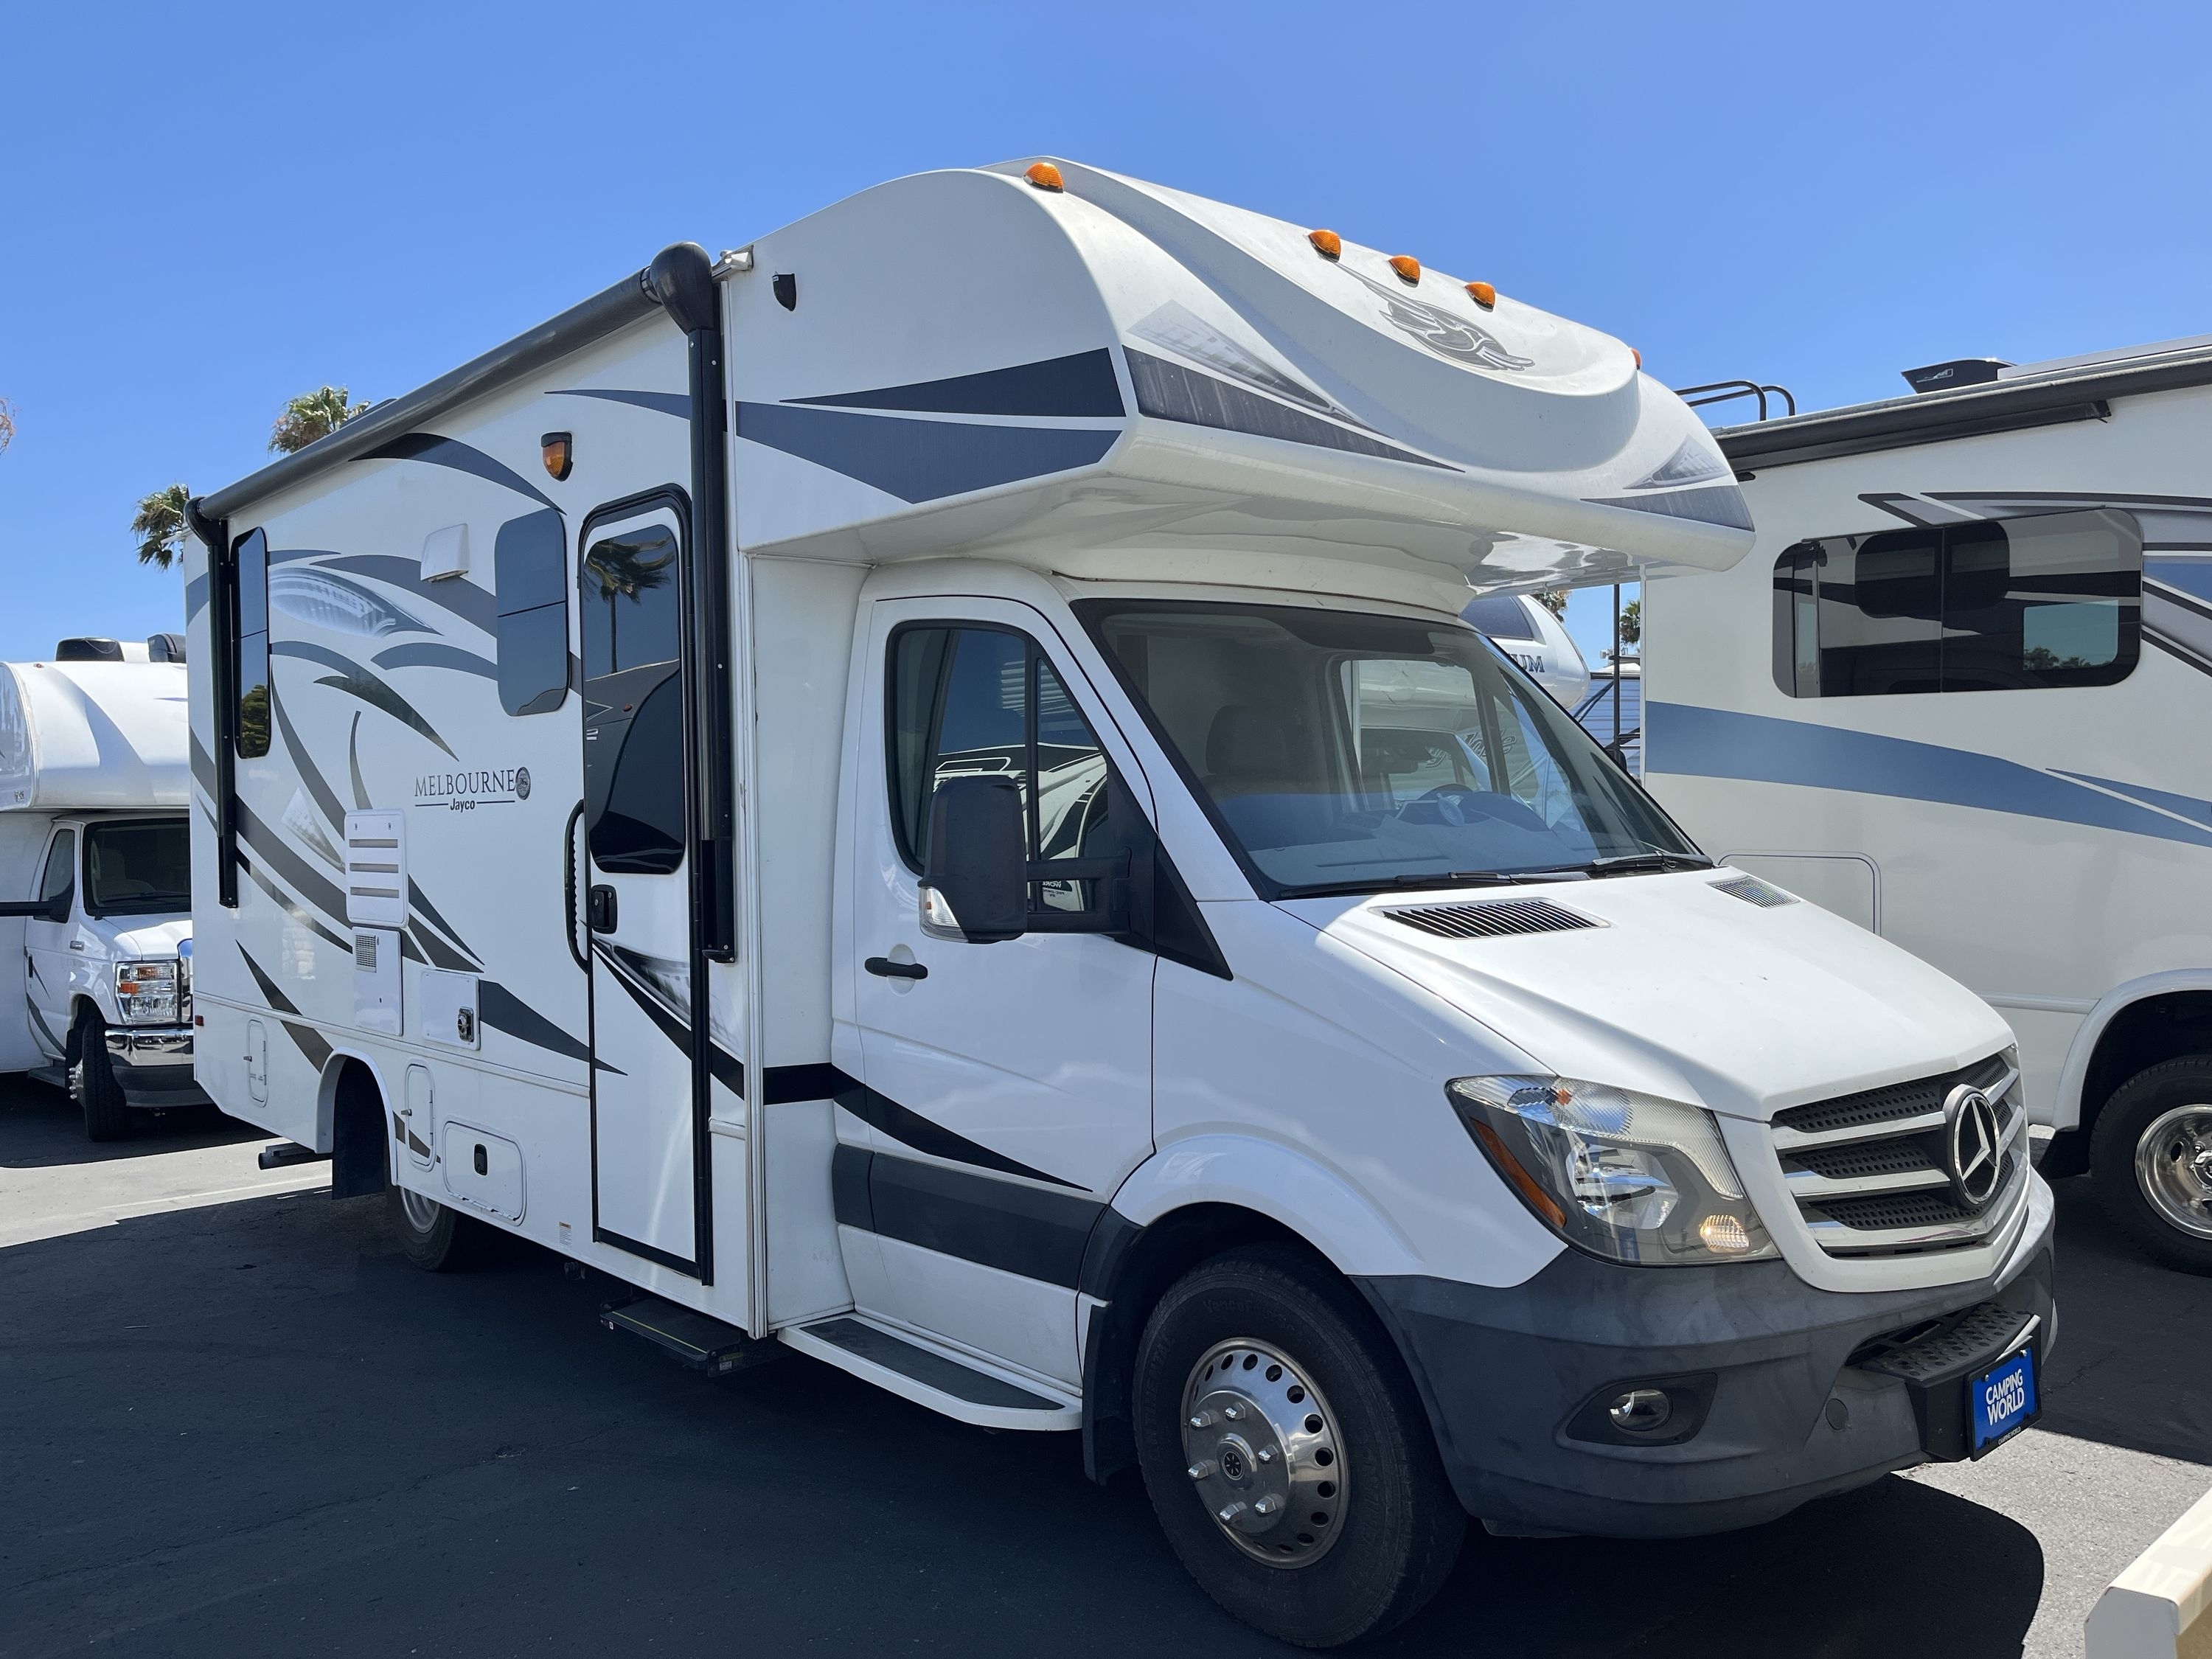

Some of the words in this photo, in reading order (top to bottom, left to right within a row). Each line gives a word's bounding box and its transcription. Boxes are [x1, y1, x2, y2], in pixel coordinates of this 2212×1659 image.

[1509, 653, 1545, 672] UM
[414, 769, 515, 796] MELBOURNE
[450, 798, 476, 813] Jayco
[1986, 1368, 2023, 1405] CAMPING
[1986, 1387, 2025, 1426] WORLD
